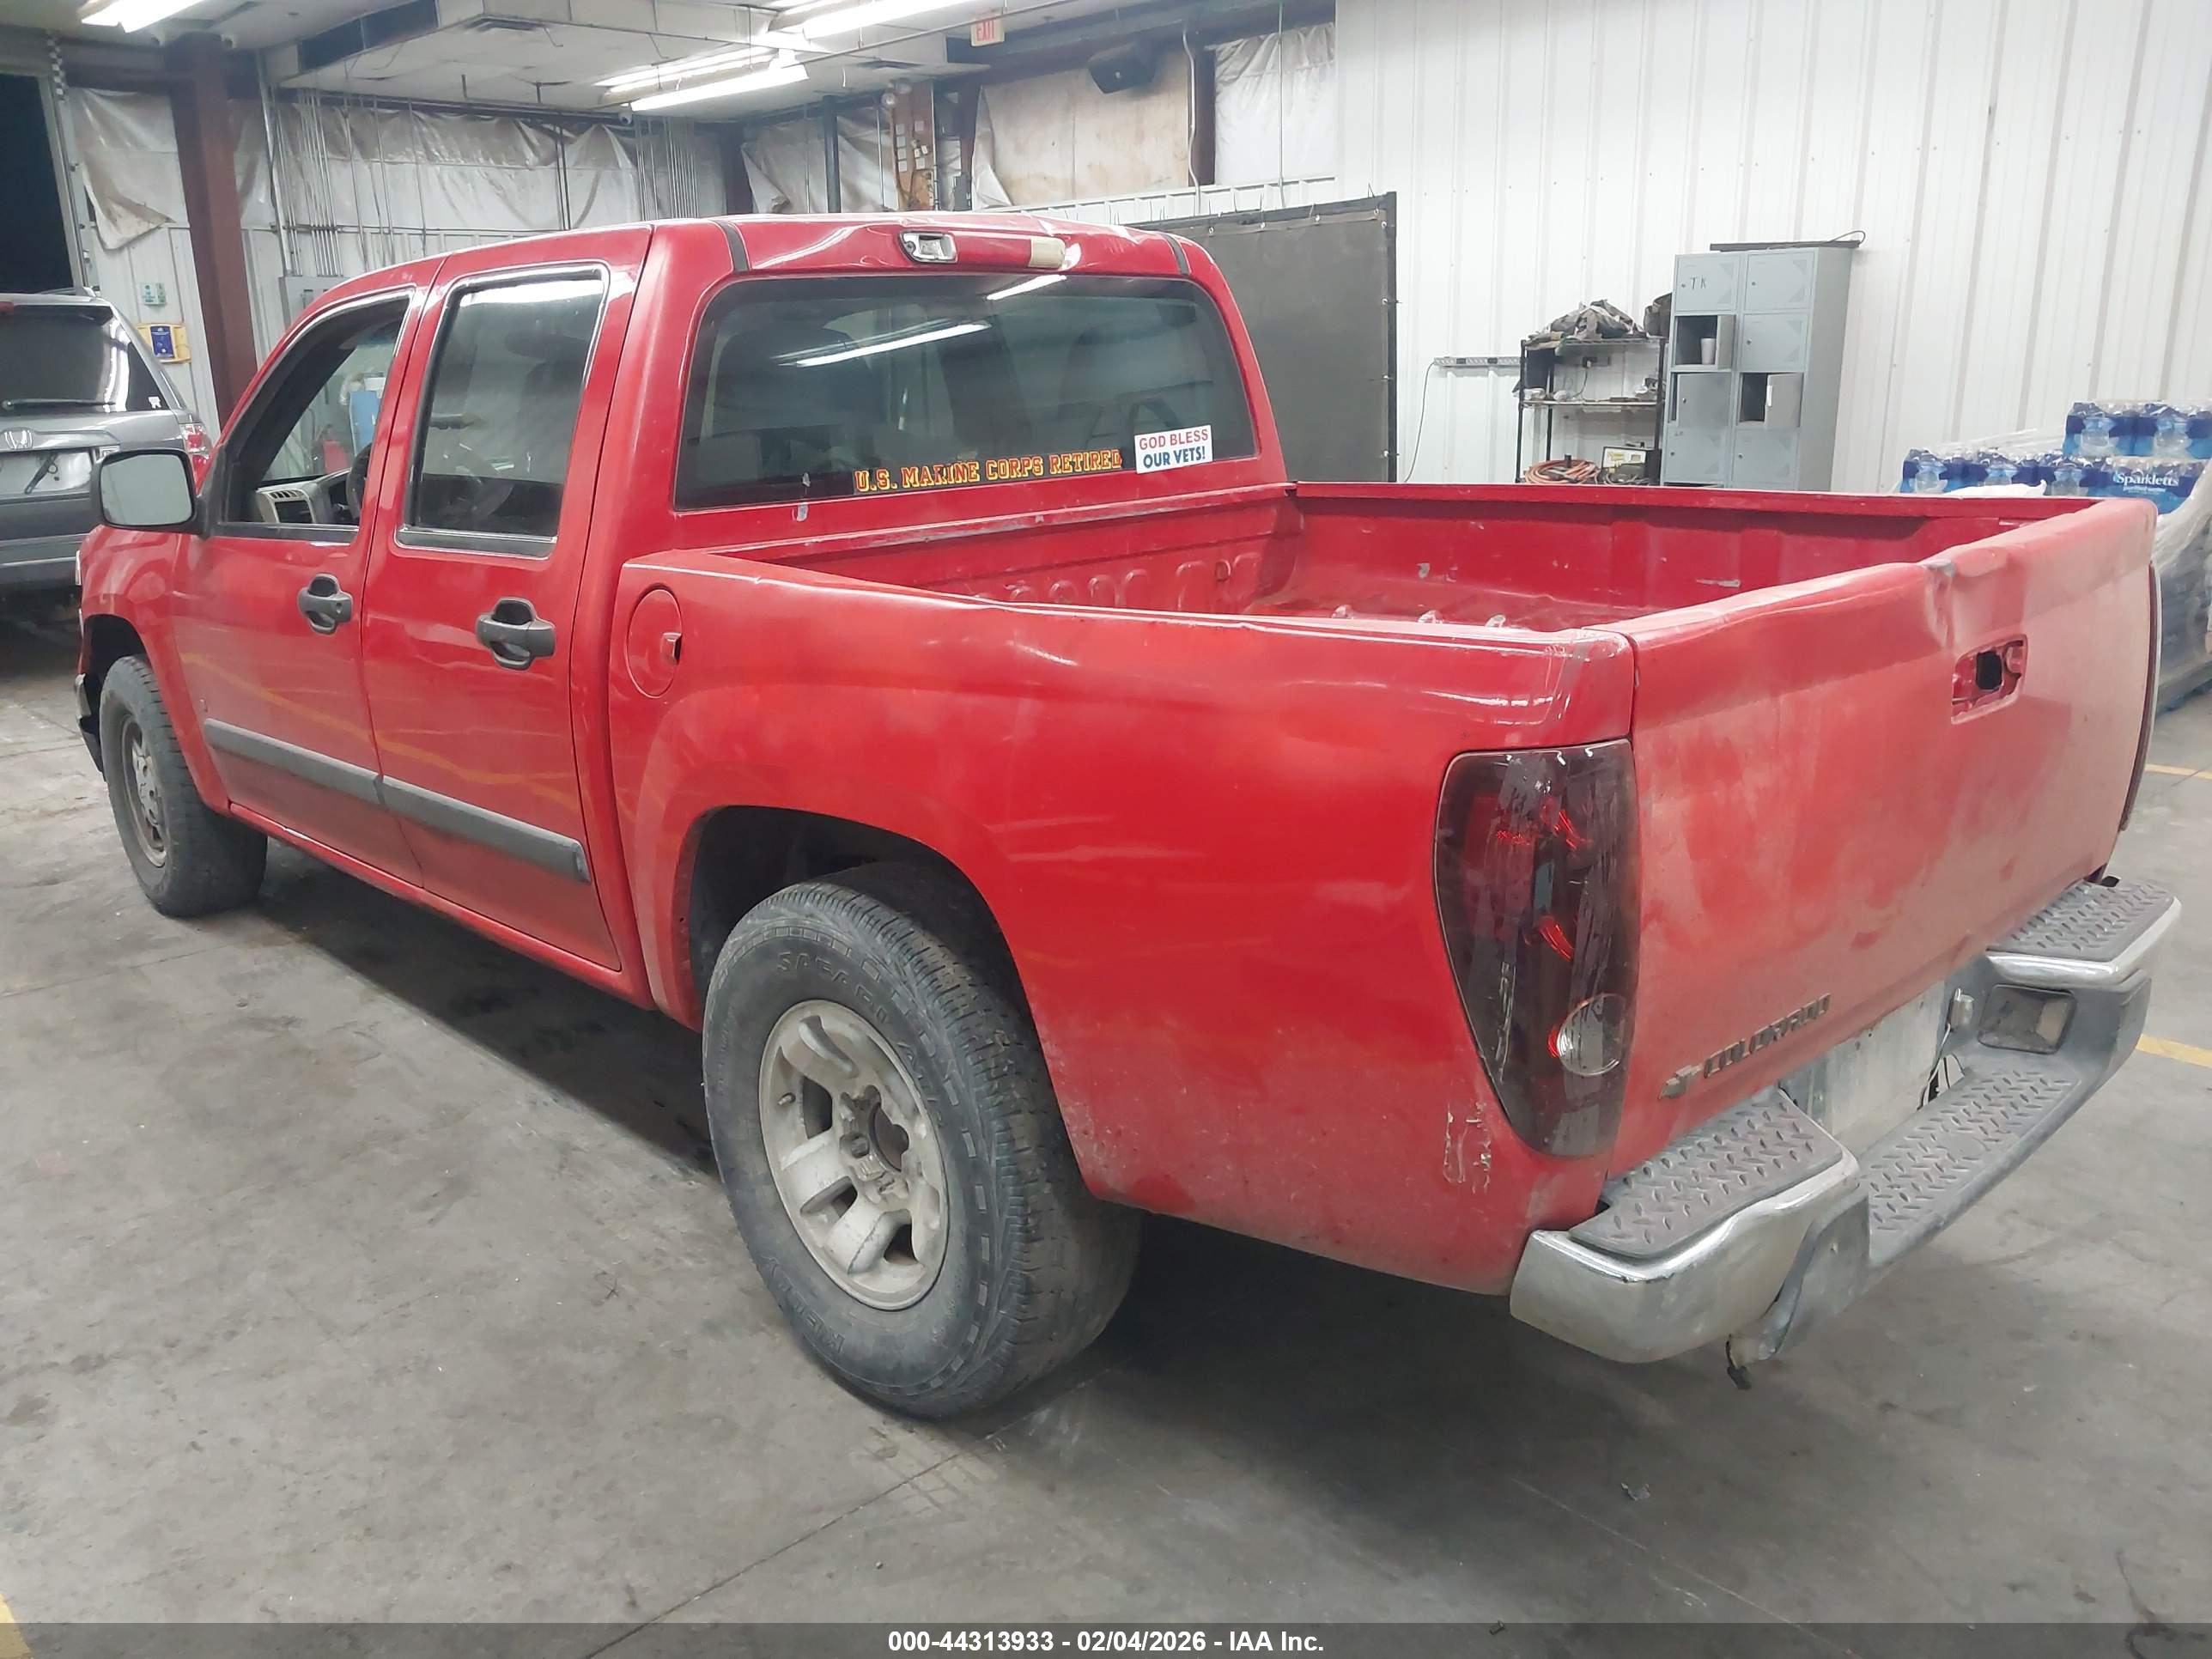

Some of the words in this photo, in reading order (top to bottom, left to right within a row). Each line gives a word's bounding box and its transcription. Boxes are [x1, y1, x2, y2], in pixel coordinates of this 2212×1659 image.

[975, 20, 996, 42] EXIT
[1139, 435, 1166, 450] GOD
[1170, 429, 1208, 446] BLESS
[1144, 452, 1170, 469] OUR
[1174, 446, 1206, 464] VETS!
[854, 468, 897, 492] U.S.
[902, 461, 980, 488] MARINE
[986, 456, 1043, 480] CORPS
[1049, 449, 1122, 475] RETIRED
[2118, 471, 2179, 487] Sparkletts
[1704, 993, 1831, 1079] COLORADO
